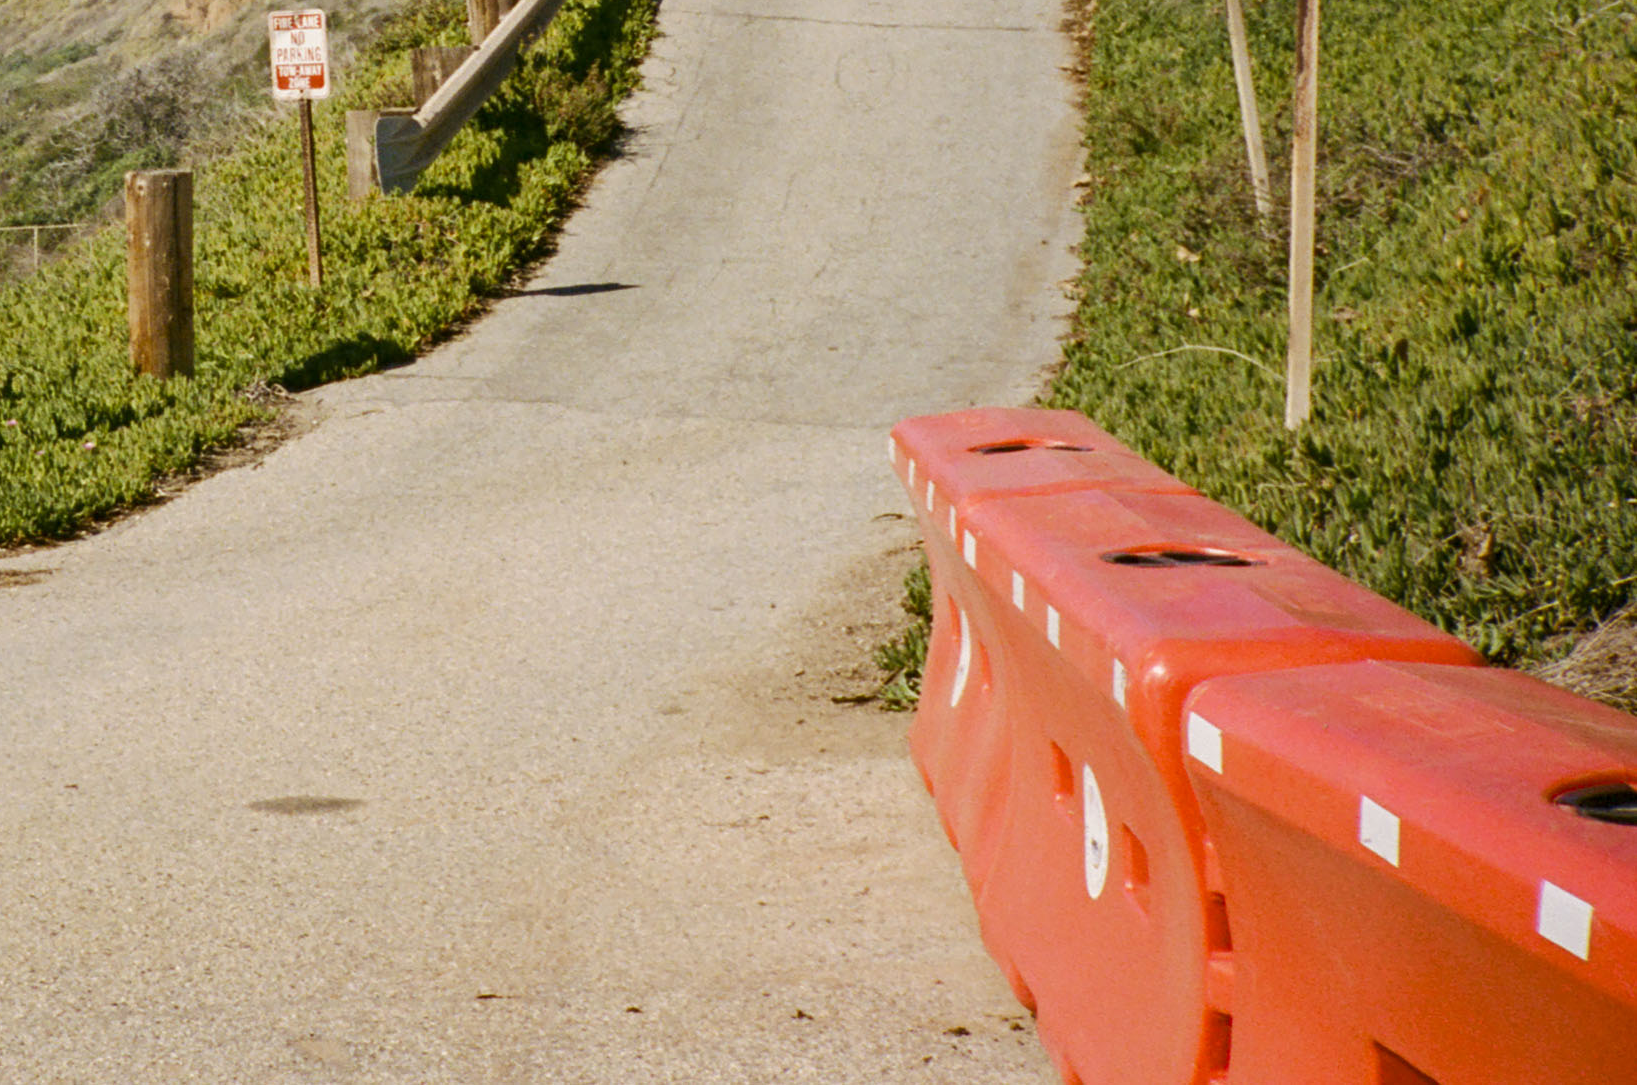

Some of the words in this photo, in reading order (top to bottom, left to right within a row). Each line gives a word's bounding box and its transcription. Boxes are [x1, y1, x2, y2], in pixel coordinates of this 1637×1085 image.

[273, 17, 293, 29] FIRE
[296, 15, 320, 28] LANE
[290, 31, 305, 46] NO
[276, 46, 322, 63] PARKING
